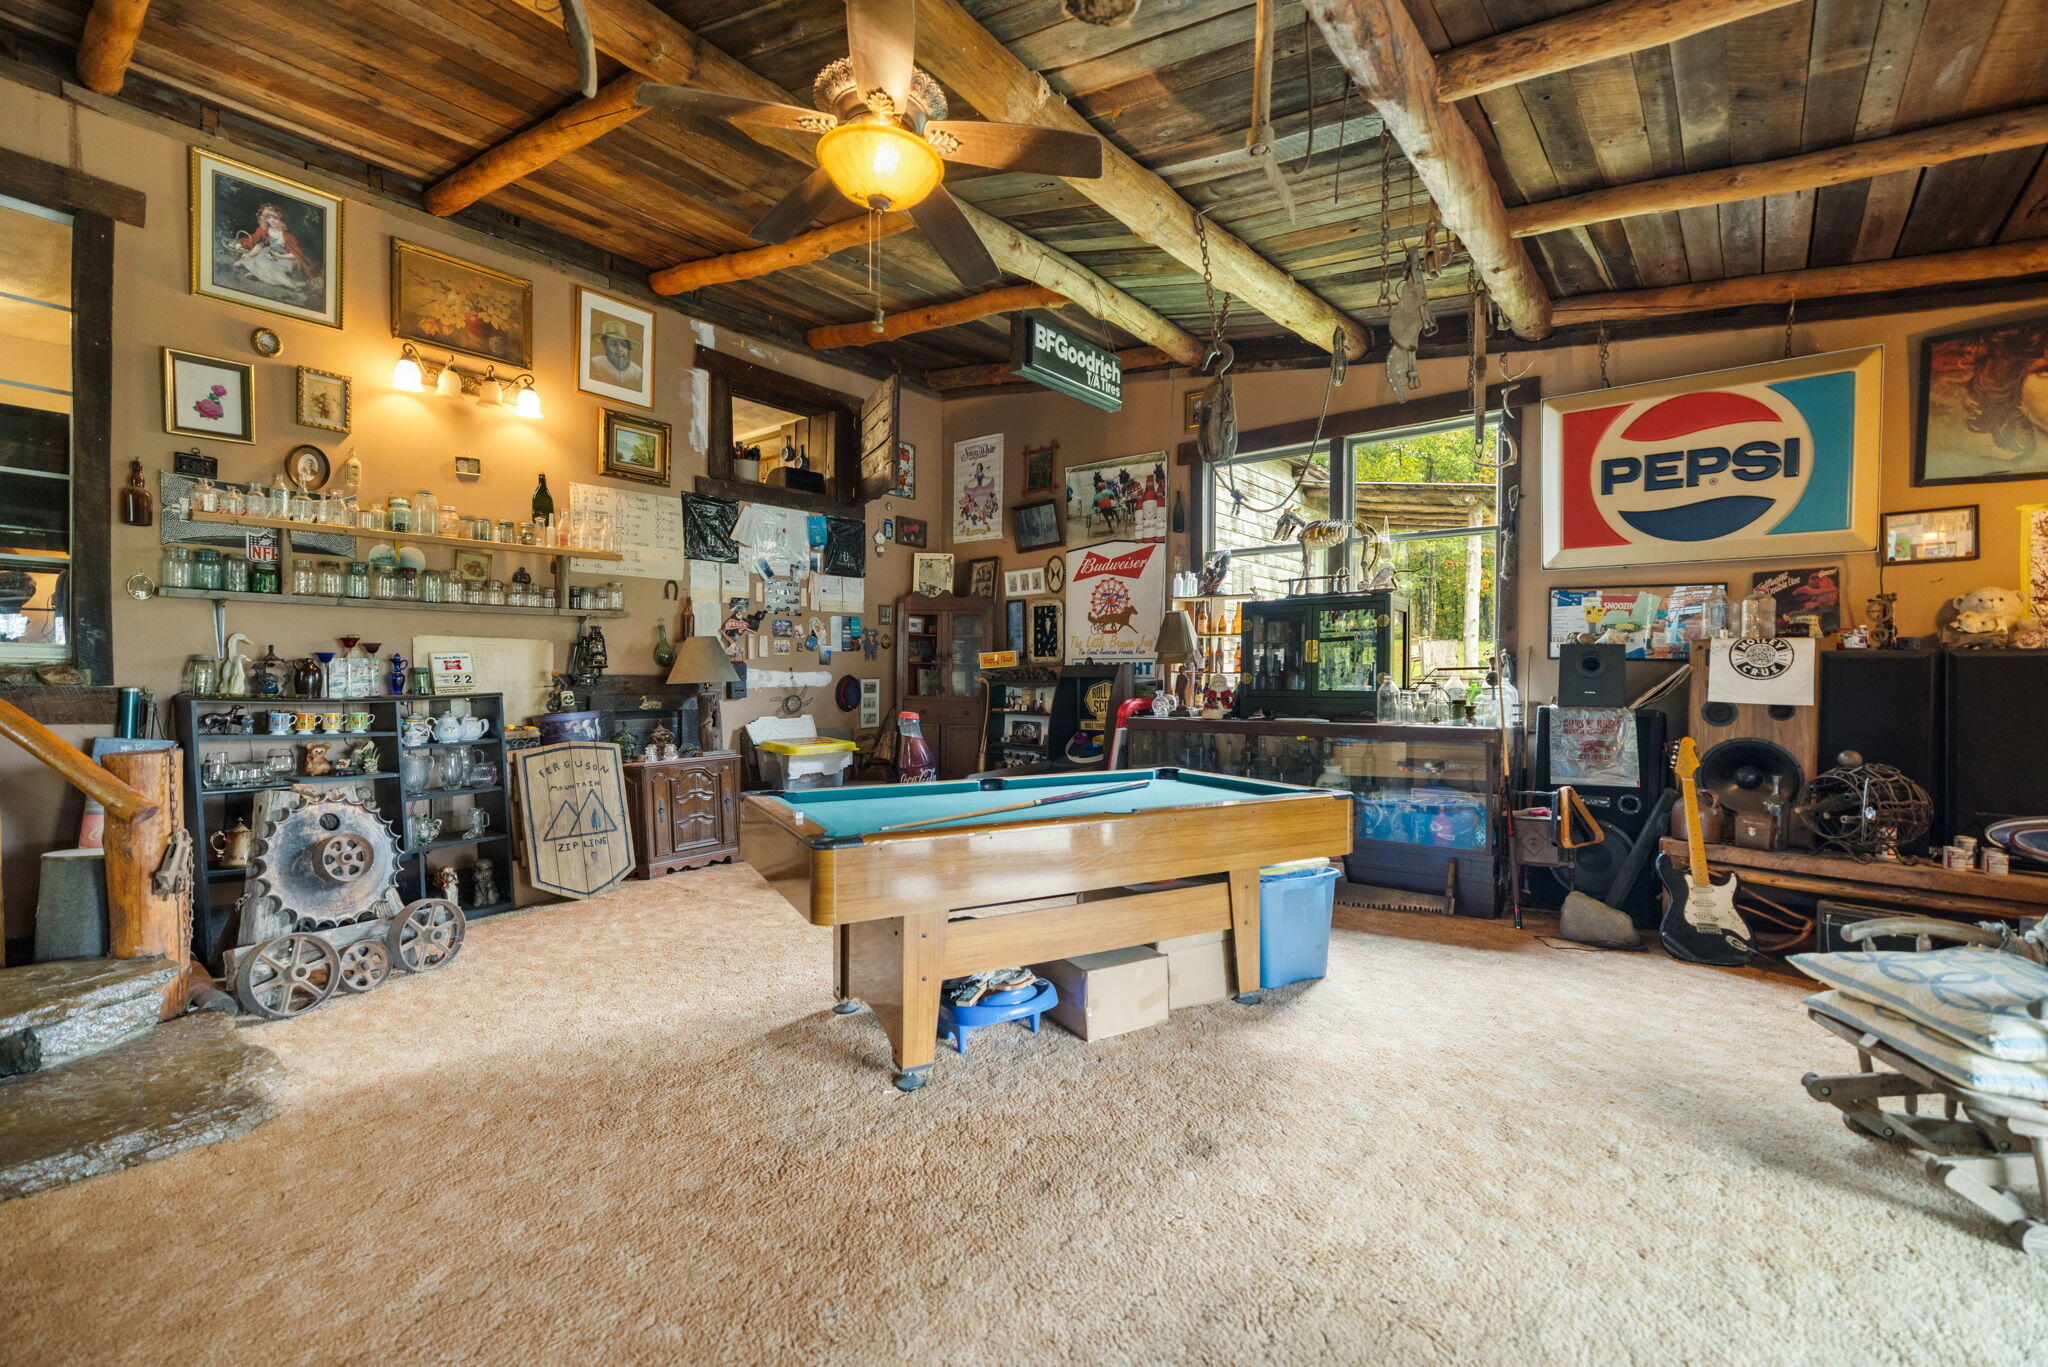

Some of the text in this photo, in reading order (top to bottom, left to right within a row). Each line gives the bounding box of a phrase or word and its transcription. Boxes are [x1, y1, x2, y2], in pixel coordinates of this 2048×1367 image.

[1035, 323, 1120, 384] BFGoodrich
[1086, 371, 1120, 397] T/A Tires
[1601, 438, 1800, 495] PEPSI
[252, 546, 278, 561] NFL
[1080, 557, 1148, 574] Budweiser
[1742, 665, 1779, 677] CRUE
[1092, 684, 1107, 699] ROLL
[539, 760, 609, 778] FERGUSON
[550, 780, 601, 792] MOUNTAIN
